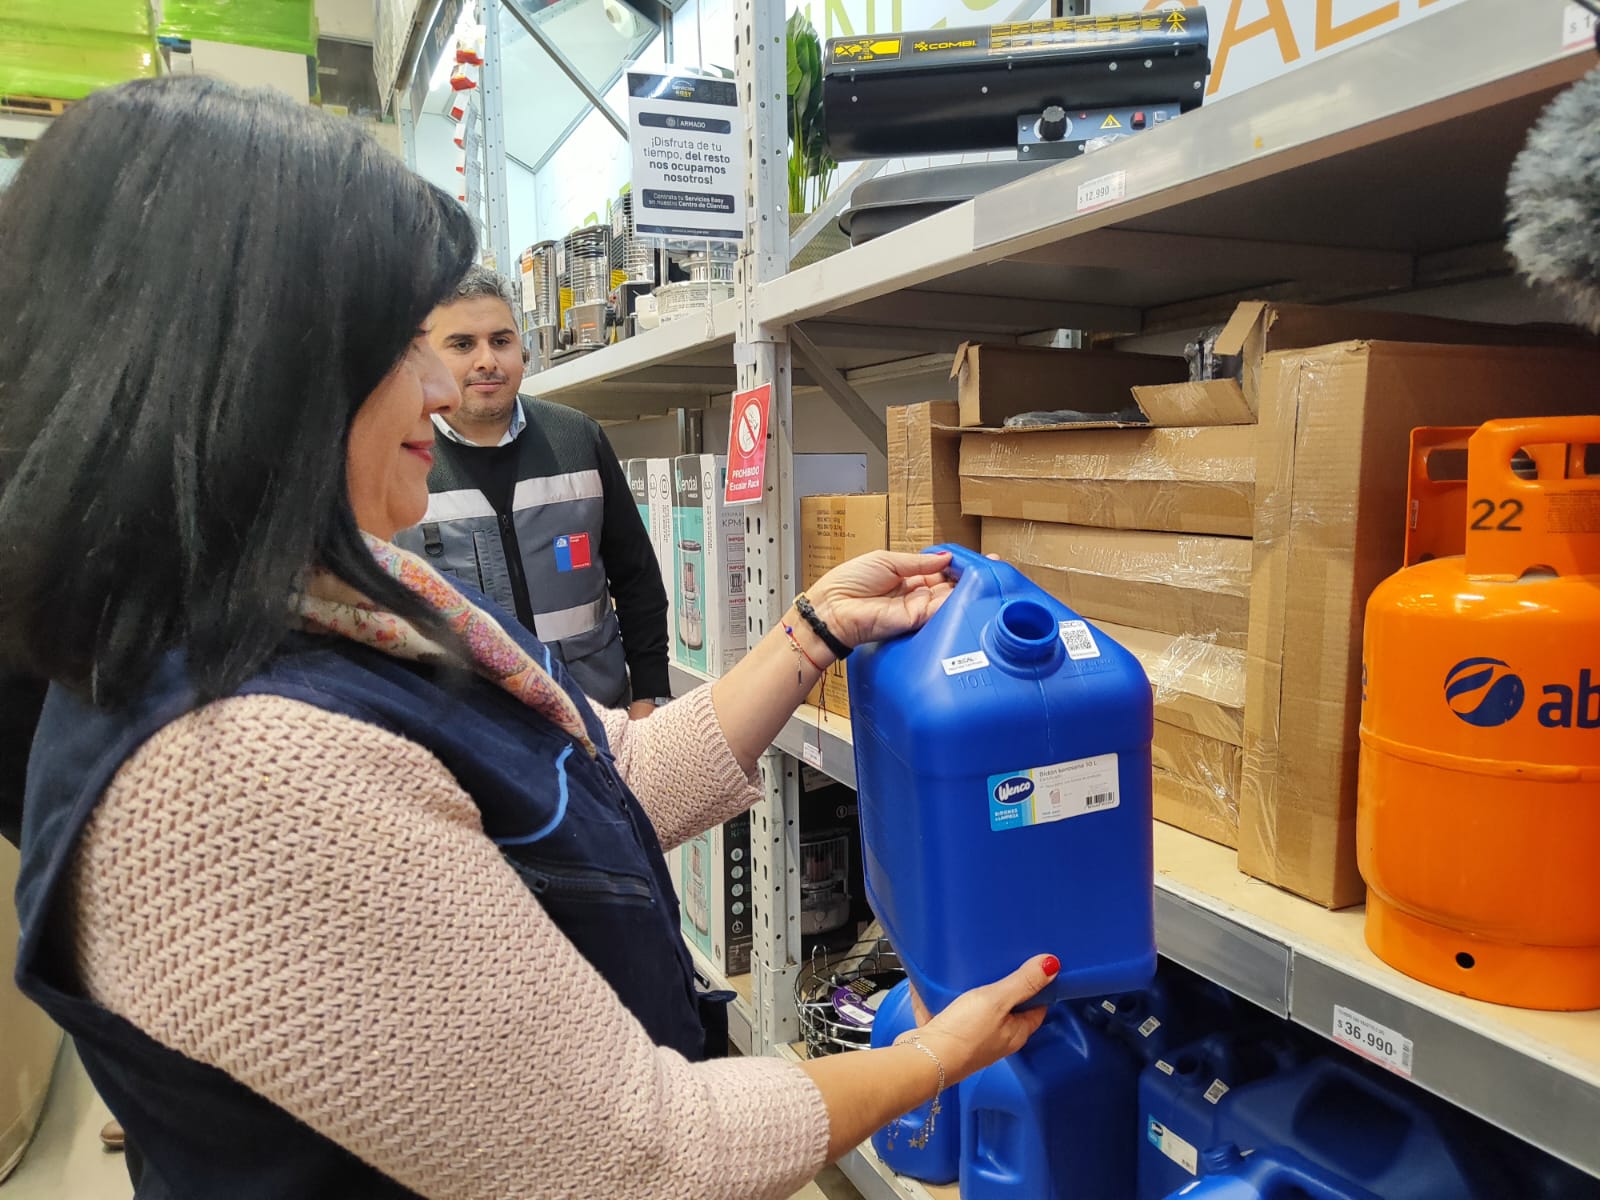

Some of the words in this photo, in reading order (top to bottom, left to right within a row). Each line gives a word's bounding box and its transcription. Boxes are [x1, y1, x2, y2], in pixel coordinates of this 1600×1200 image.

[680, 120, 706, 129] ARMADO
[651, 136, 694, 149] ¡Disfruta
[697, 140, 709, 151] de
[712, 142, 722, 152] tu
[643, 147, 683, 160] tiempo,
[685, 151, 701, 161] del
[704, 153, 730, 164] resto
[649, 160, 669, 170] nos
[671, 162, 726, 175] ocupamos
[663, 173, 713, 185] nosotros!
[678, 200, 698, 208] Centro
[684, 194, 710, 204] Servicios
[732, 465, 760, 479] PROHIBIDO
[1470, 498, 1524, 531] 22
[722, 518, 744, 528] KPM-
[1537, 669, 1600, 729] ab
[998, 780, 1031, 802] Wenco
[1344, 1021, 1393, 1056] 36.990
